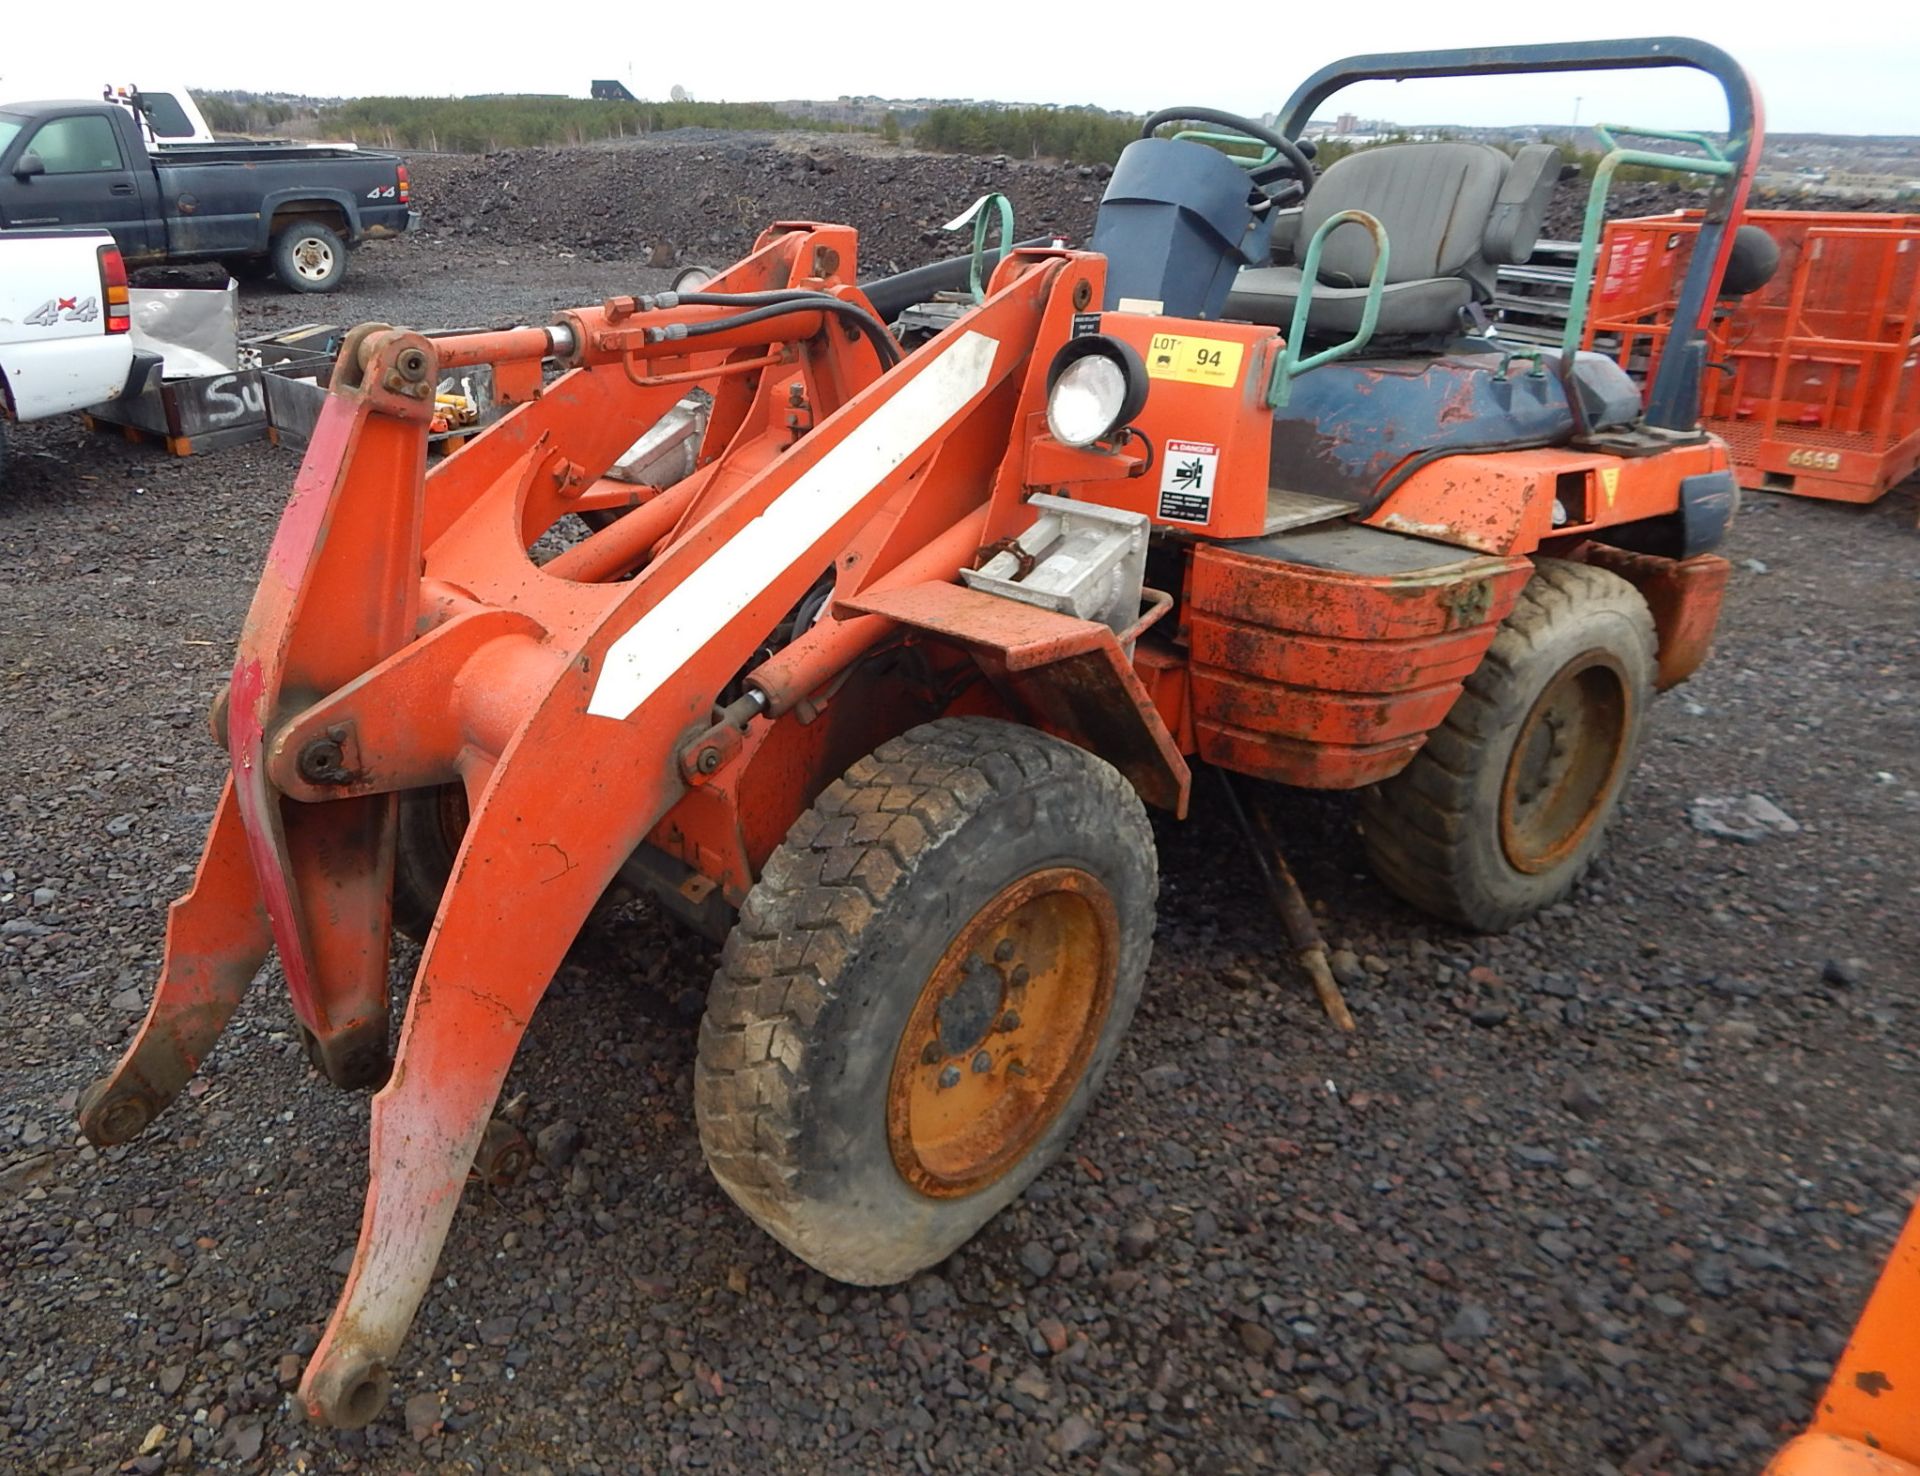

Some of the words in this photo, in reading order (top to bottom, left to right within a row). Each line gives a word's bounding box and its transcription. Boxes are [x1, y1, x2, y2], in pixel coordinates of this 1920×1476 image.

[1153, 337, 1178, 350] LOT
[1196, 348, 1222, 367] 94
[1179, 444, 1214, 454] DANGER
